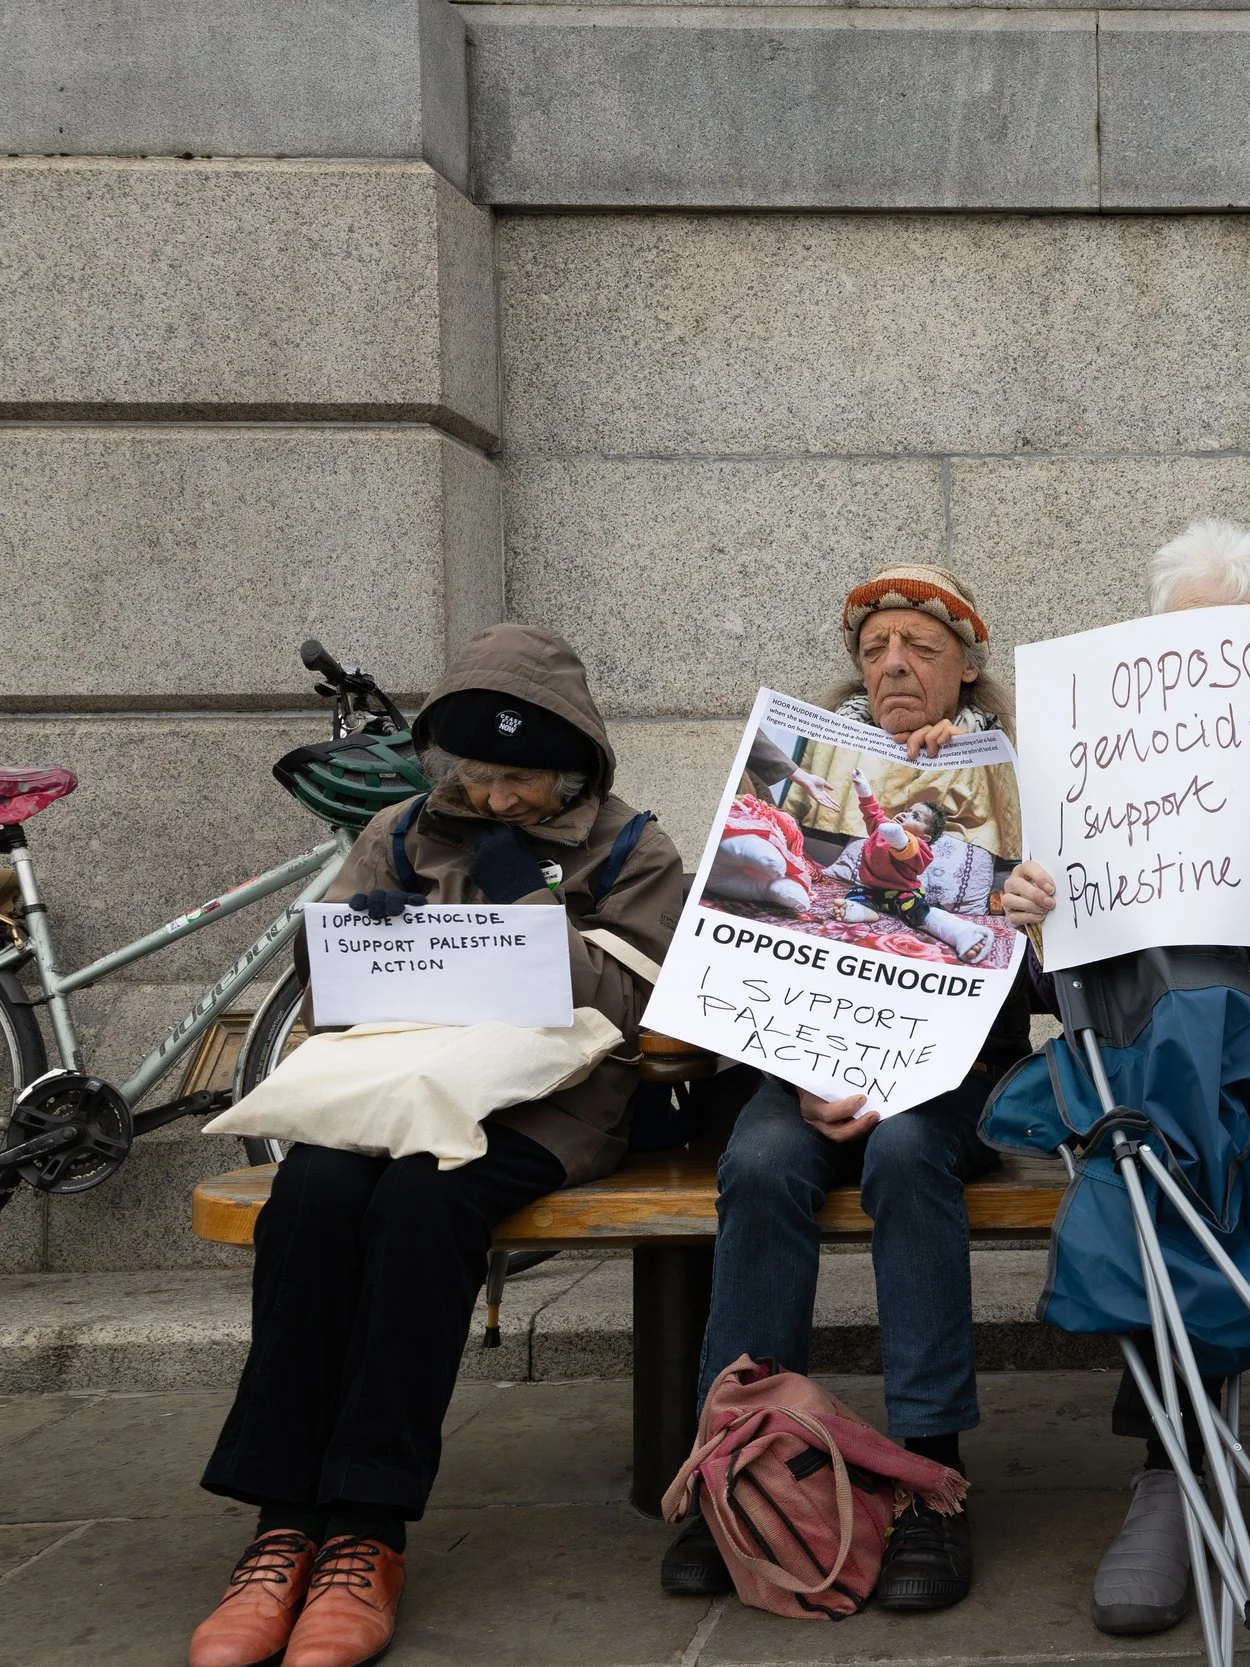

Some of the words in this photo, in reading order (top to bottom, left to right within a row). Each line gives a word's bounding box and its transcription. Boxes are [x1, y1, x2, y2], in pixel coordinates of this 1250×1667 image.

[770, 708, 786, 717] when
[811, 723, 824, 731] only
[772, 699, 790, 709] HOOR
[791, 706, 818, 719] NUDDEIR
[819, 715, 830, 723] lost
[842, 724, 861, 733] father,
[863, 730, 884, 738] mother
[1072, 674, 1076, 729] I
[767, 716, 786, 727] fingers
[808, 729, 821, 739] right
[822, 735, 839, 743] hand.
[867, 747, 887, 755] almost
[889, 752, 920, 766] incessantly
[1058, 802, 1063, 856] I
[1084, 774, 1227, 847] support
[1066, 852, 1241, 929] Palestine
[323, 916, 326, 928] I
[403, 912, 504, 925] GENOCIDE
[325, 939, 328, 952] I
[339, 939, 414, 953] SUPPORT
[430, 935, 526, 949] PALESTINE
[371, 959, 443, 974] ACTION
[695, 918, 705, 936] I
[713, 923, 830, 970] OPPOSE
[837, 954, 985, 996] GENOCIDE
[701, 966, 710, 989] I
[742, 979, 928, 1039] SUPPORT
[697, 994, 936, 1070] PALESTINE
[741, 1031, 896, 1102] ACTION
